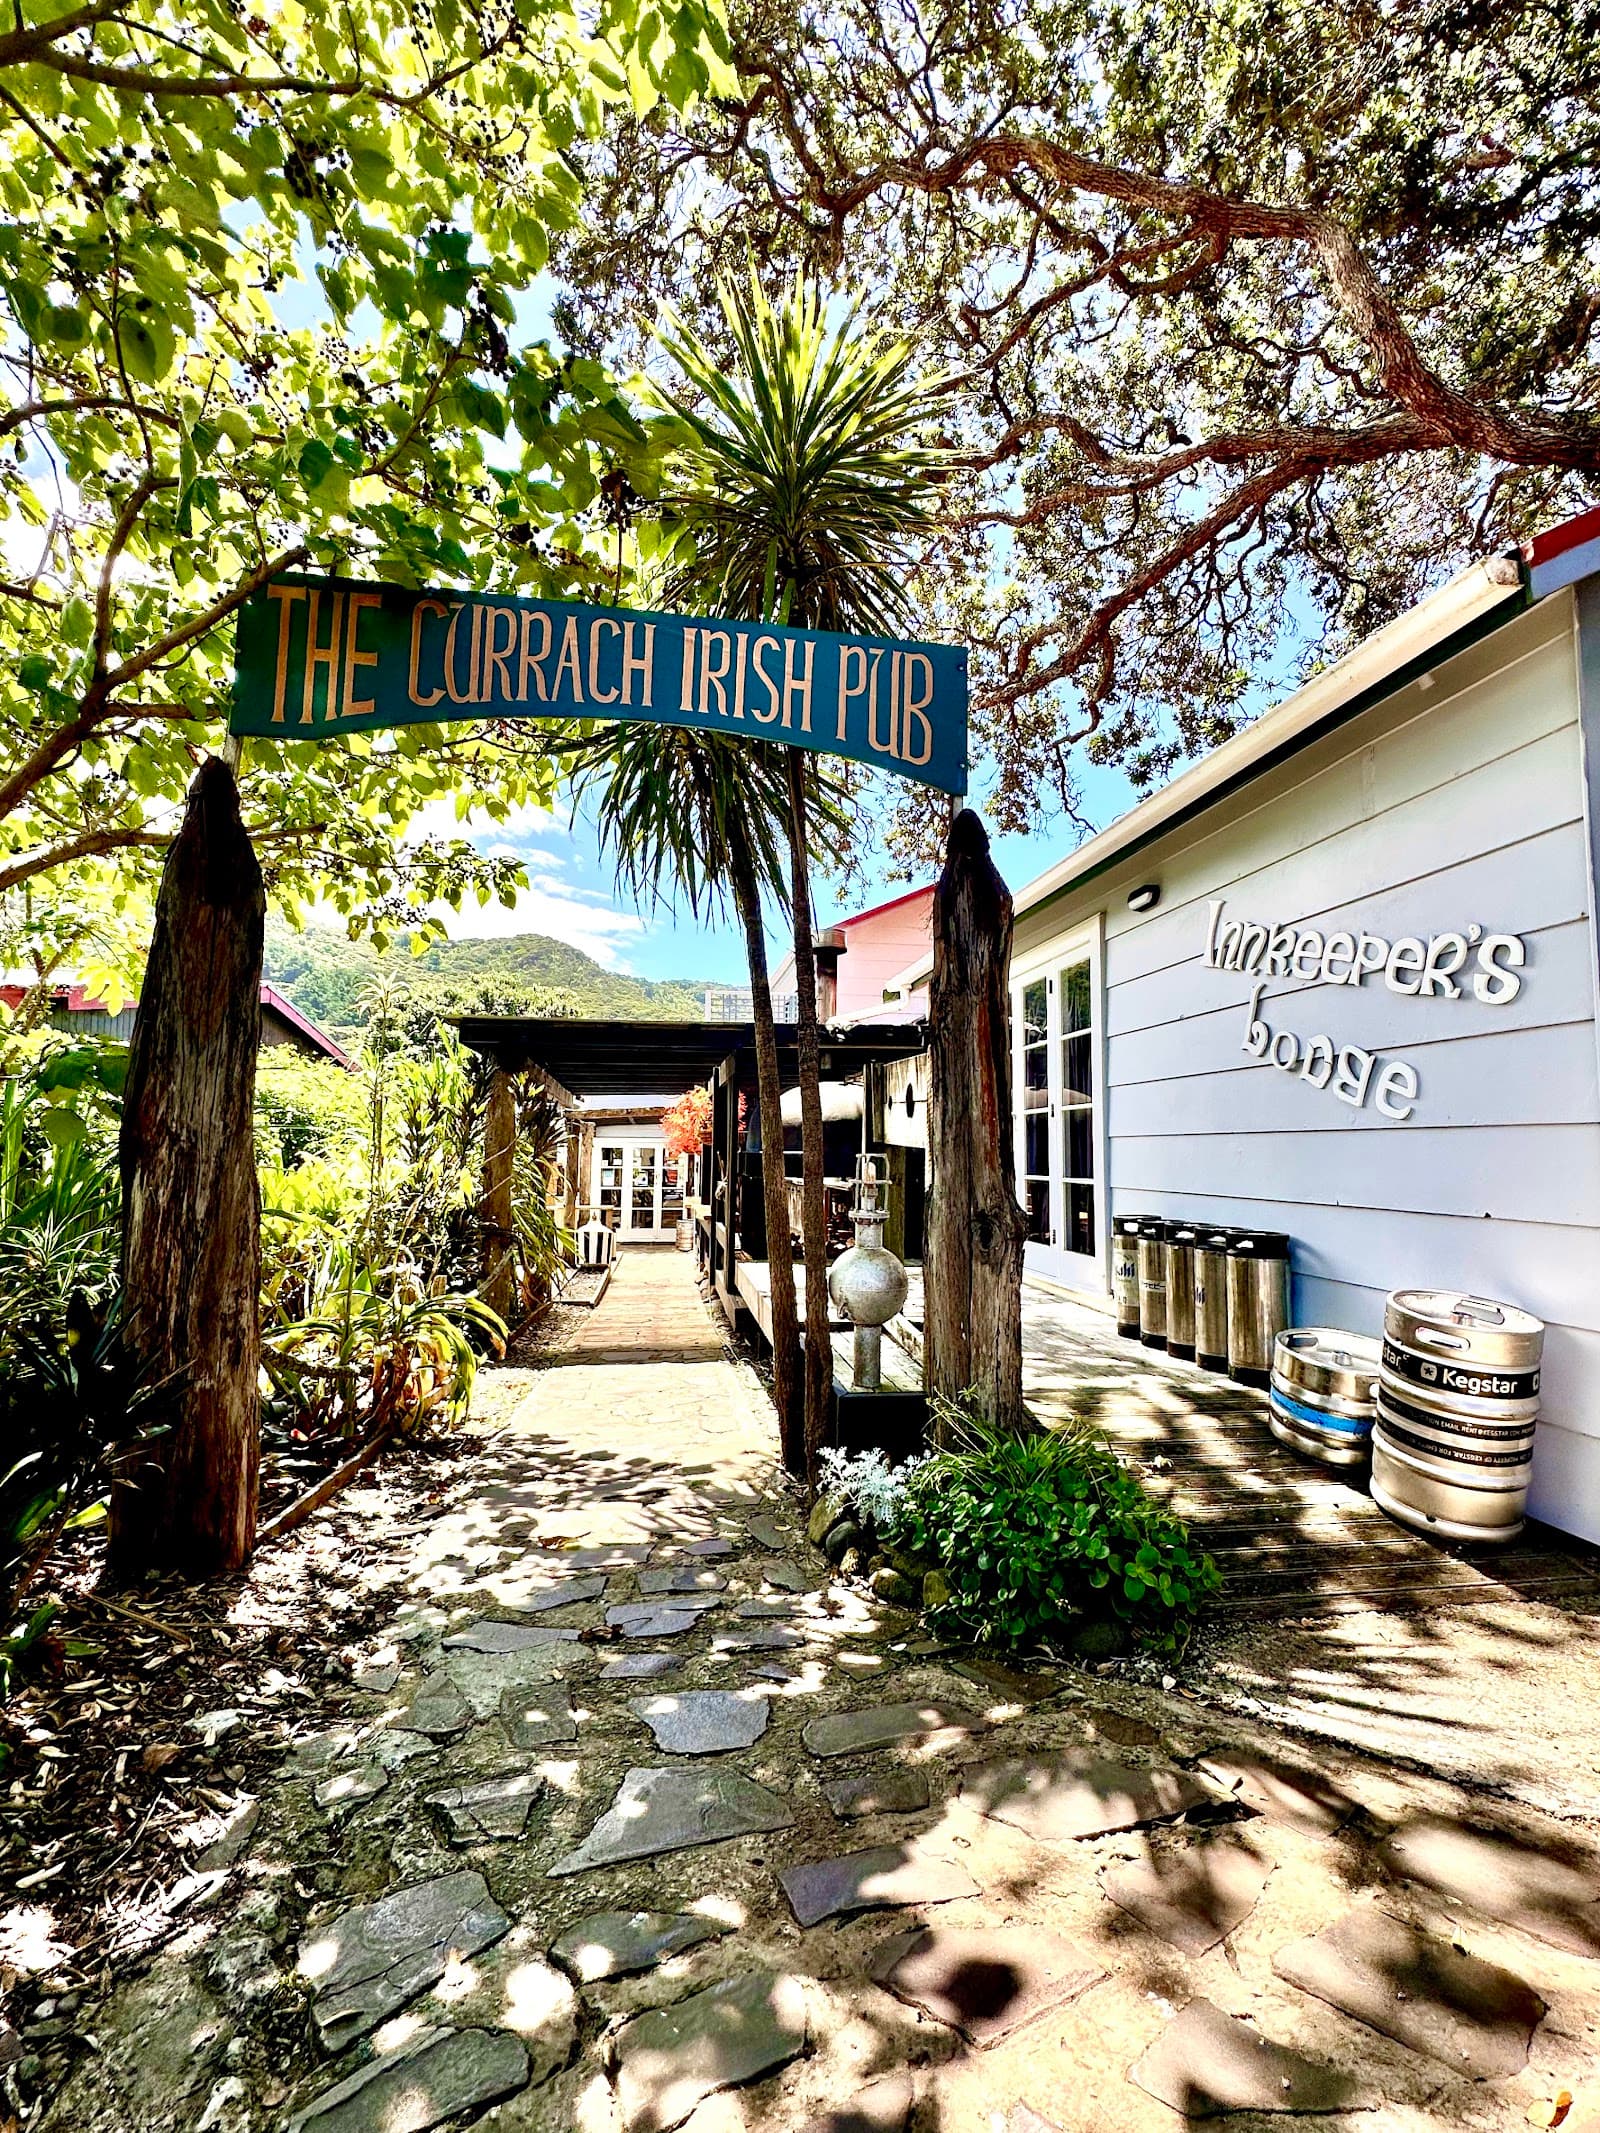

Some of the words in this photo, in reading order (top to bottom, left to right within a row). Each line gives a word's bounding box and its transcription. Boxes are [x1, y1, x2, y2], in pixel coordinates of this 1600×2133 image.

[267, 583, 383, 724] THE
[407, 599, 657, 707] CURRACH
[680, 627, 815, 733] IRISH
[836, 644, 934, 766] PUB
[1442, 1367, 1518, 1395] Kegstar
